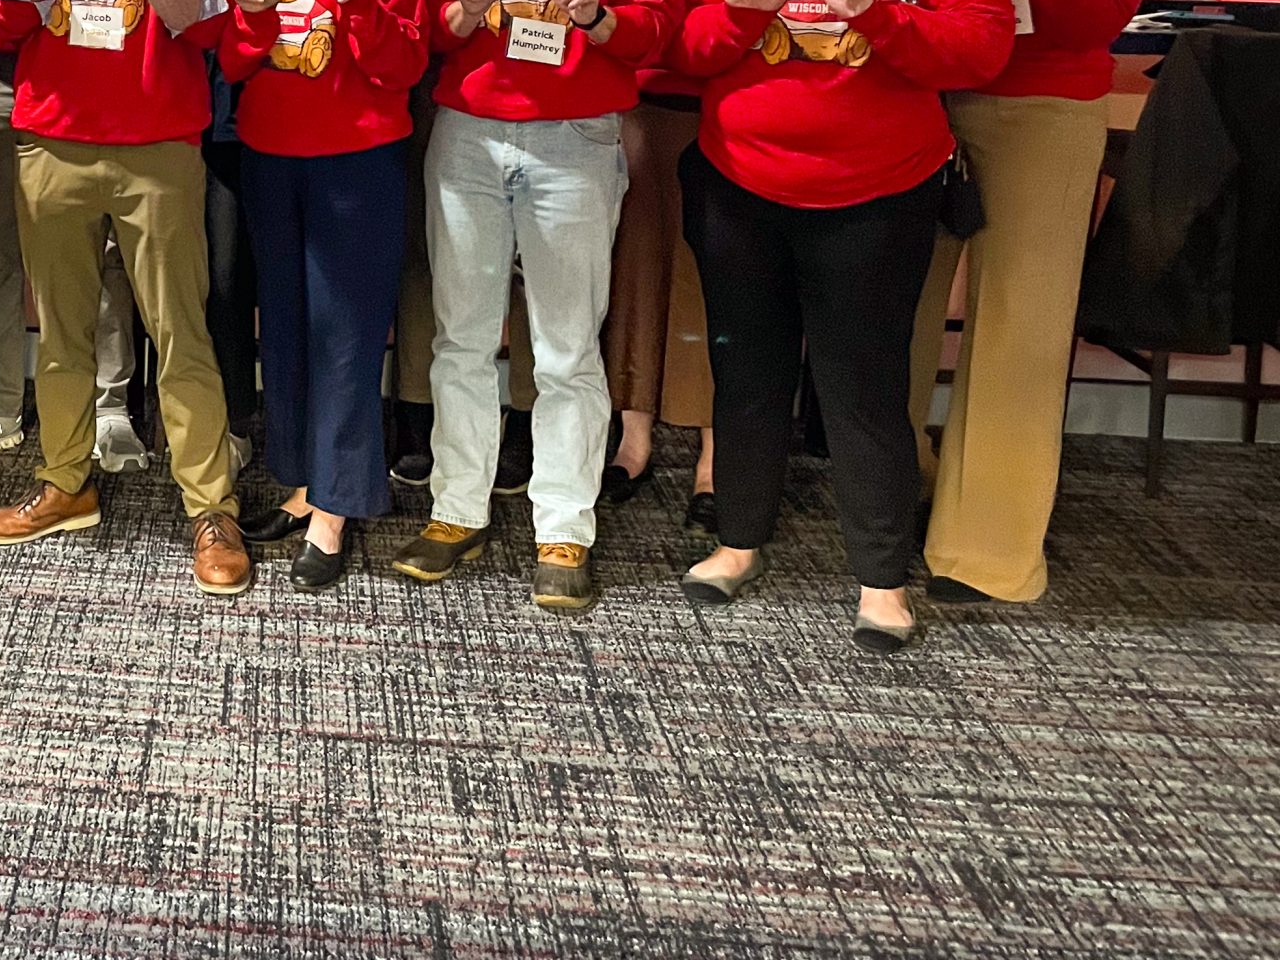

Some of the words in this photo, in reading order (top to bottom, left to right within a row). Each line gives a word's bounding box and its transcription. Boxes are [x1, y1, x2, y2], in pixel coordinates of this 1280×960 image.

[82, 13, 112, 22] Jacob
[521, 27, 555, 40] Patrick
[511, 39, 561, 54] Humphrey
